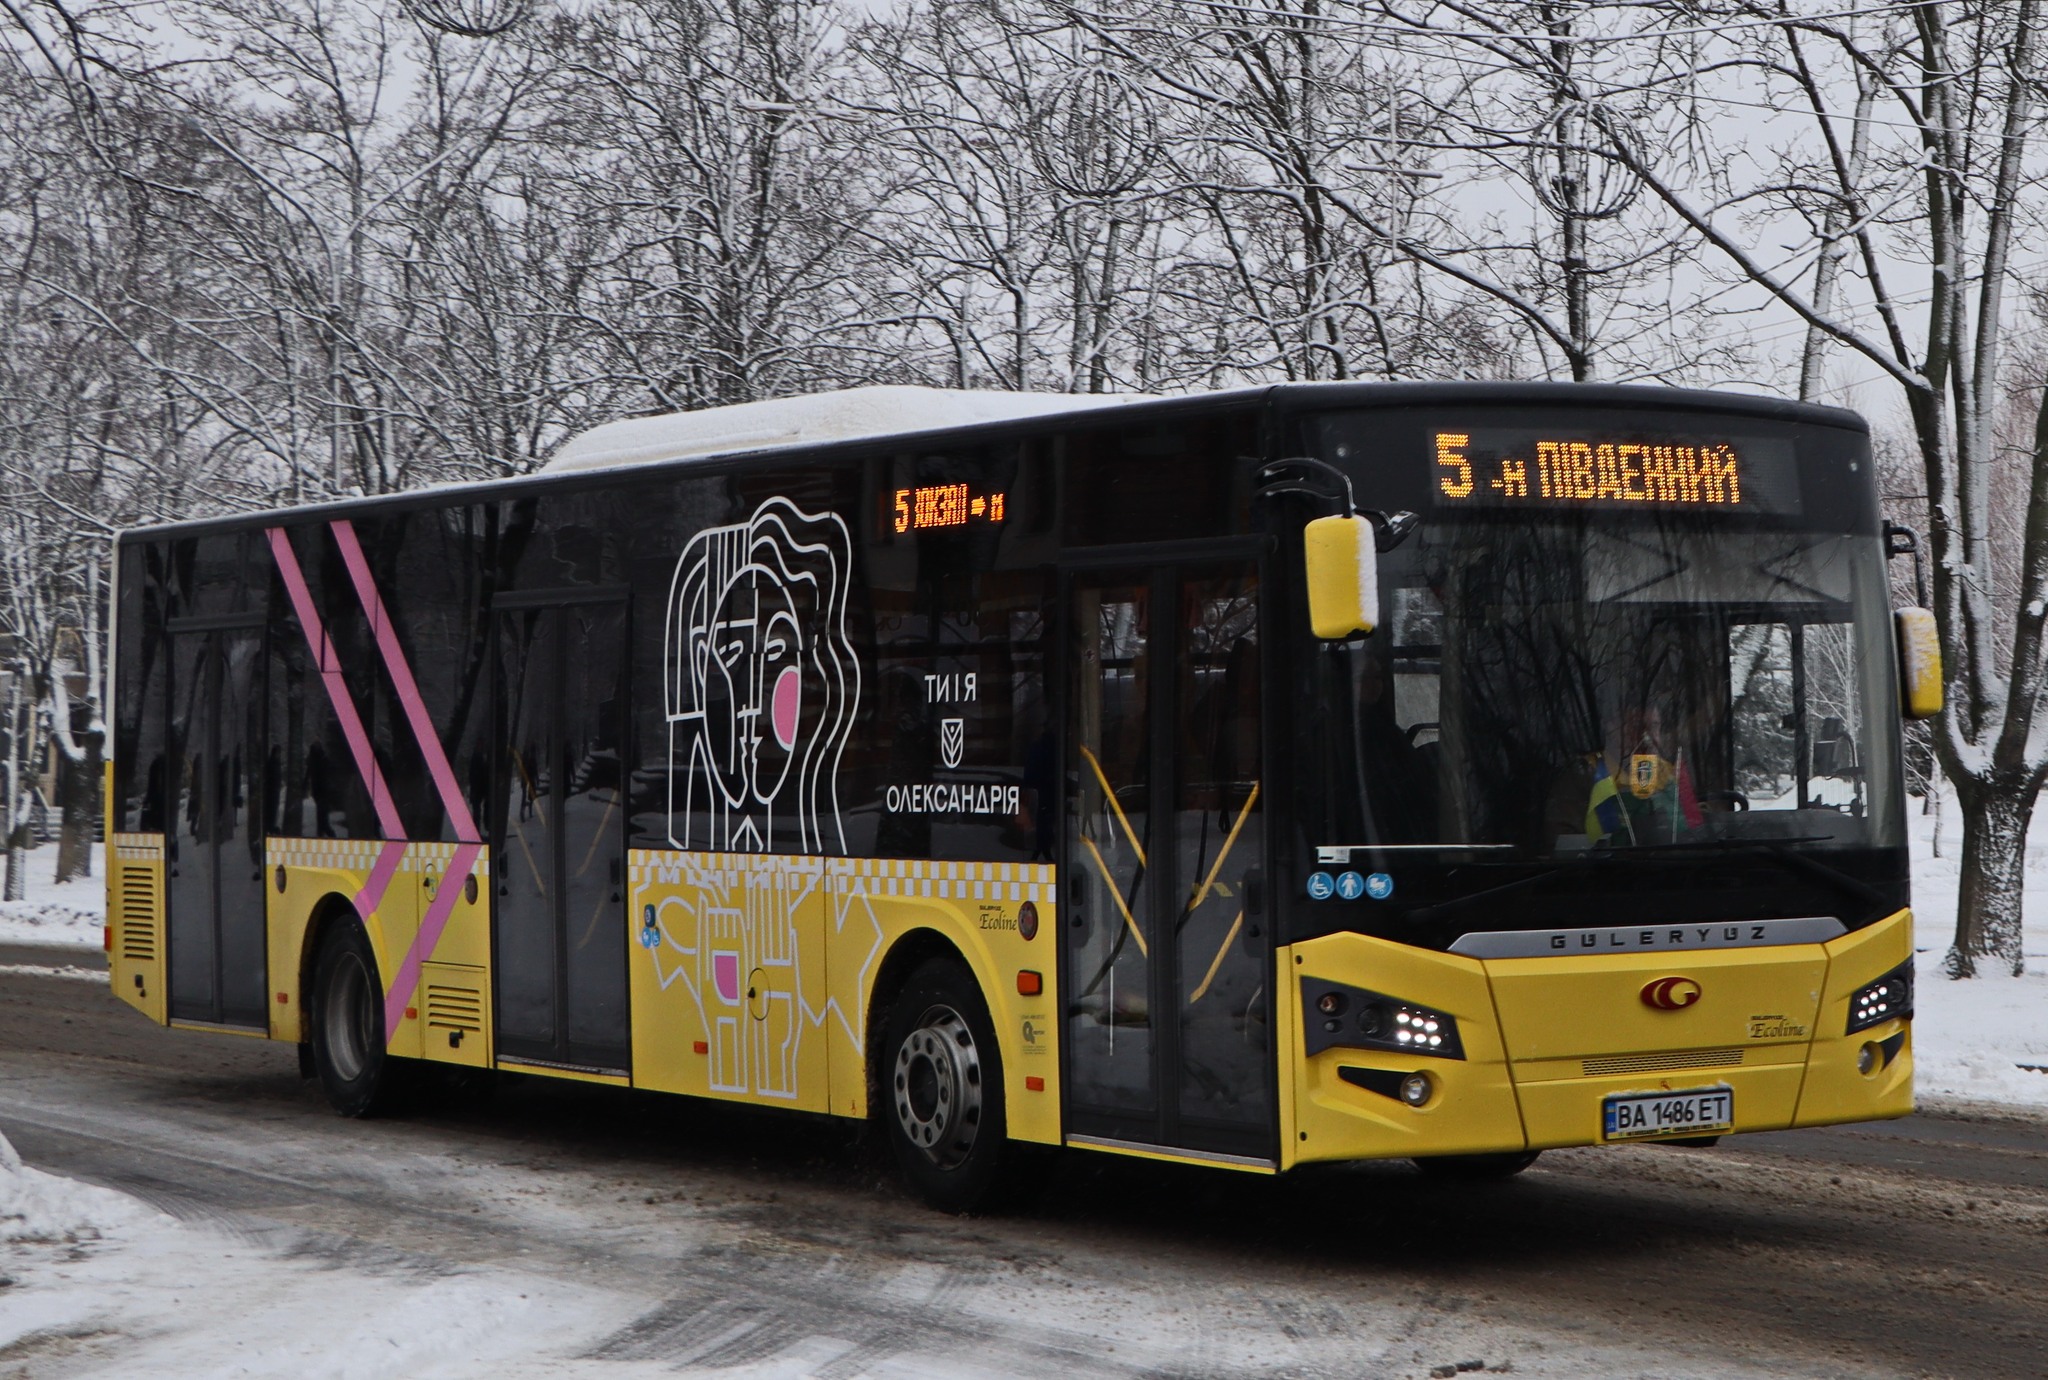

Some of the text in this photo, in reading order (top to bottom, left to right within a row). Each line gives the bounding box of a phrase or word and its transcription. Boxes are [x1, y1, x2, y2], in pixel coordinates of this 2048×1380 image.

[1436, 433, 1473, 498] 5
[1537, 441, 1740, 503] ПІВДЕННИЙ
[895, 489, 910, 533] 5
[964, 672, 977, 702] Я
[886, 784, 1020, 815] ОЛЕКСАНДРІЯ
[979, 910, 1018, 931] Ecoline
[1750, 1018, 1805, 1038] Ecoline
[1618, 1096, 1727, 1129] BA 1486 ET
